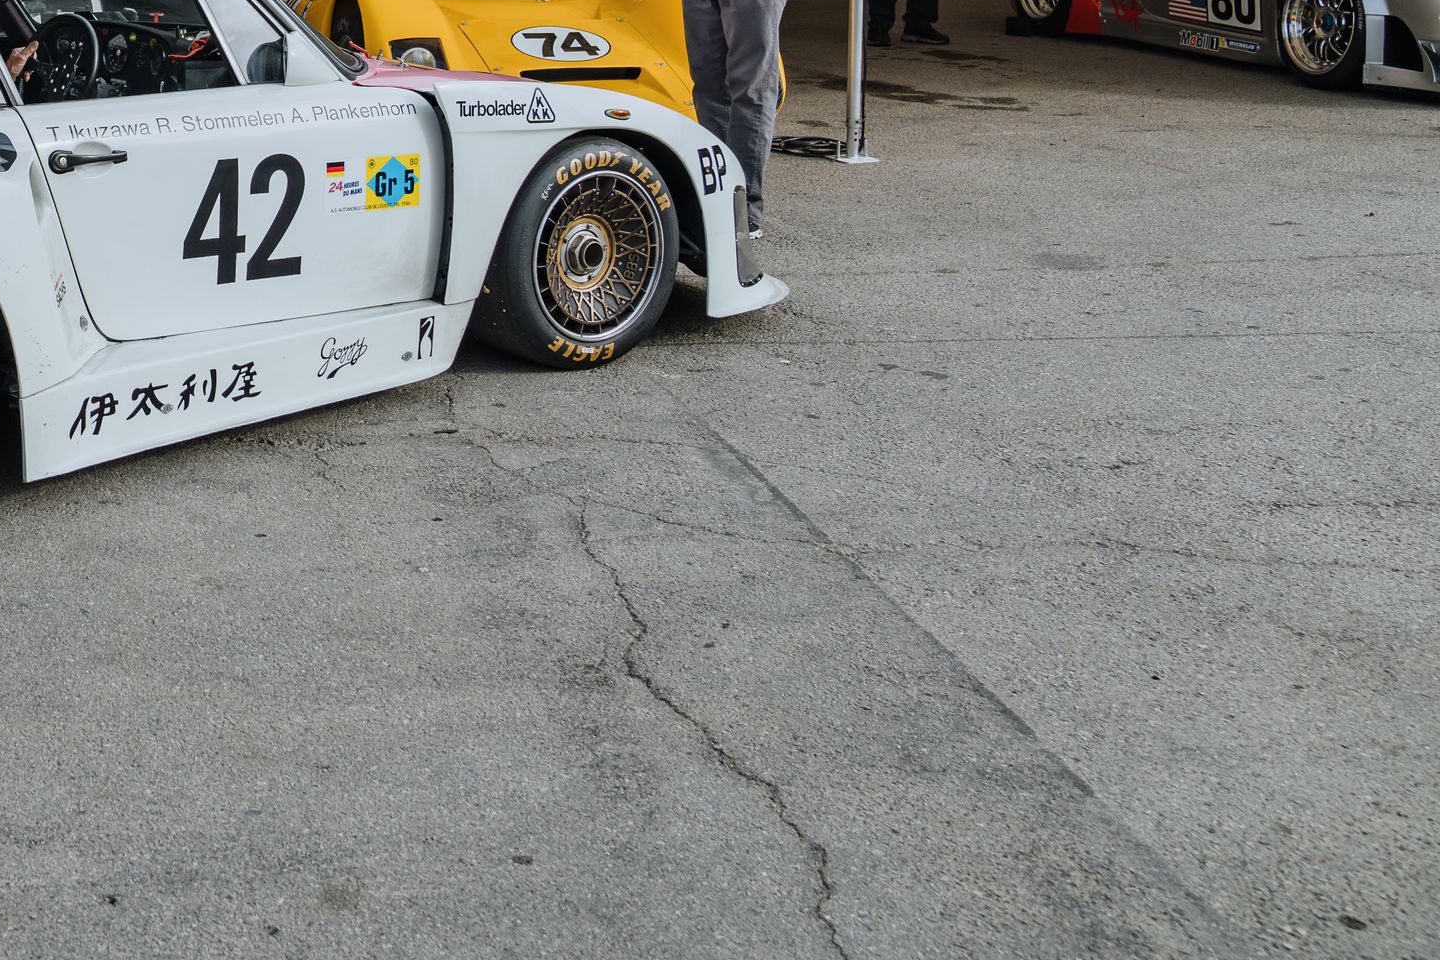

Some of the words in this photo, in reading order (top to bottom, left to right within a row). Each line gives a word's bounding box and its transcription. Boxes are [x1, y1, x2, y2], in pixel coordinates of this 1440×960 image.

[521, 31, 601, 57] 74
[1179, 29, 1209, 50] Mobil
[68, 122, 152, 141] Ikuzawa
[157, 117, 177, 135] R.
[181, 110, 286, 133] Stommelen
[291, 106, 309, 124] A.
[312, 101, 418, 122] Plankenhorn
[456, 100, 527, 118] Turbolader
[409, 157, 419, 166] 80
[697, 144, 727, 196] BP
[328, 181, 343, 193] 24
[343, 180, 360, 189] HEURES
[343, 189, 350, 197] DU
[350, 187, 363, 196] MANS
[374, 171, 398, 197] Gr
[403, 168, 415, 195] 5
[182, 153, 306, 285] 42
[624, 252, 641, 280] BBS
[547, 335, 616, 363] EAGLE
